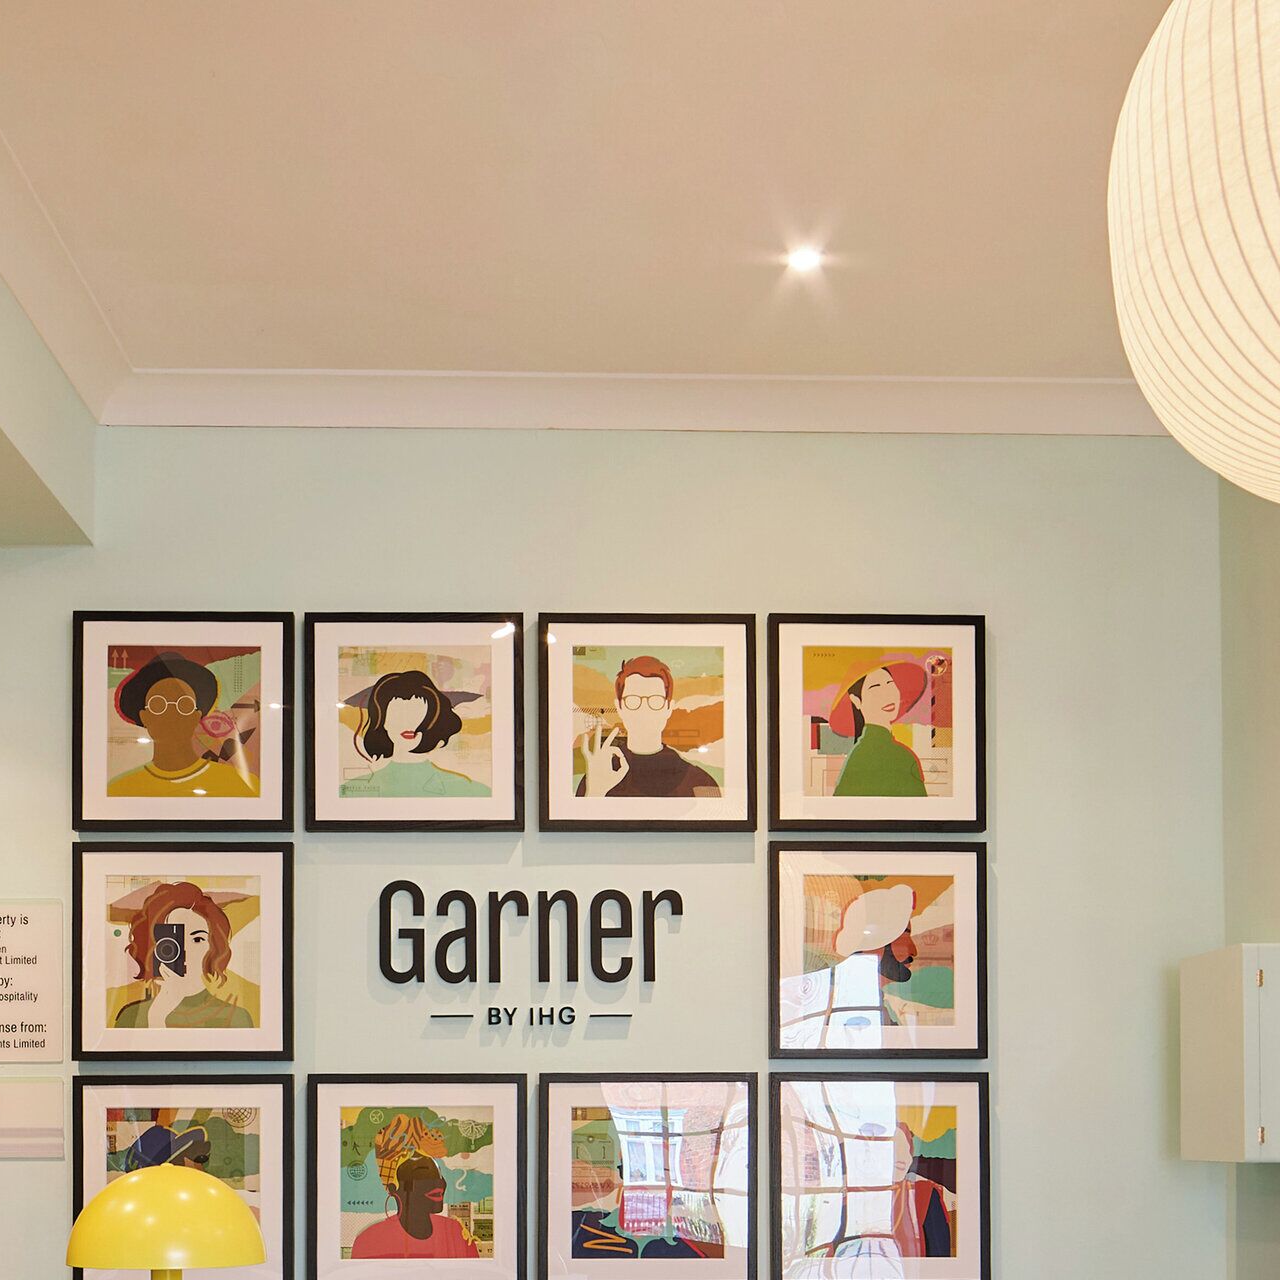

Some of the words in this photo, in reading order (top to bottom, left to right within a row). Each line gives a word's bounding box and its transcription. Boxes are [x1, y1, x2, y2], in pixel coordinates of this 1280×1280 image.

[20, 913, 29, 926] is
[379, 880, 684, 984] Garner
[5, 955, 37, 965] Limited
[487, 1007, 518, 1026] BY
[529, 1006, 576, 1027] IHG
[20, 1021, 47, 1033] from:
[13, 1038, 46, 1049] Limited
